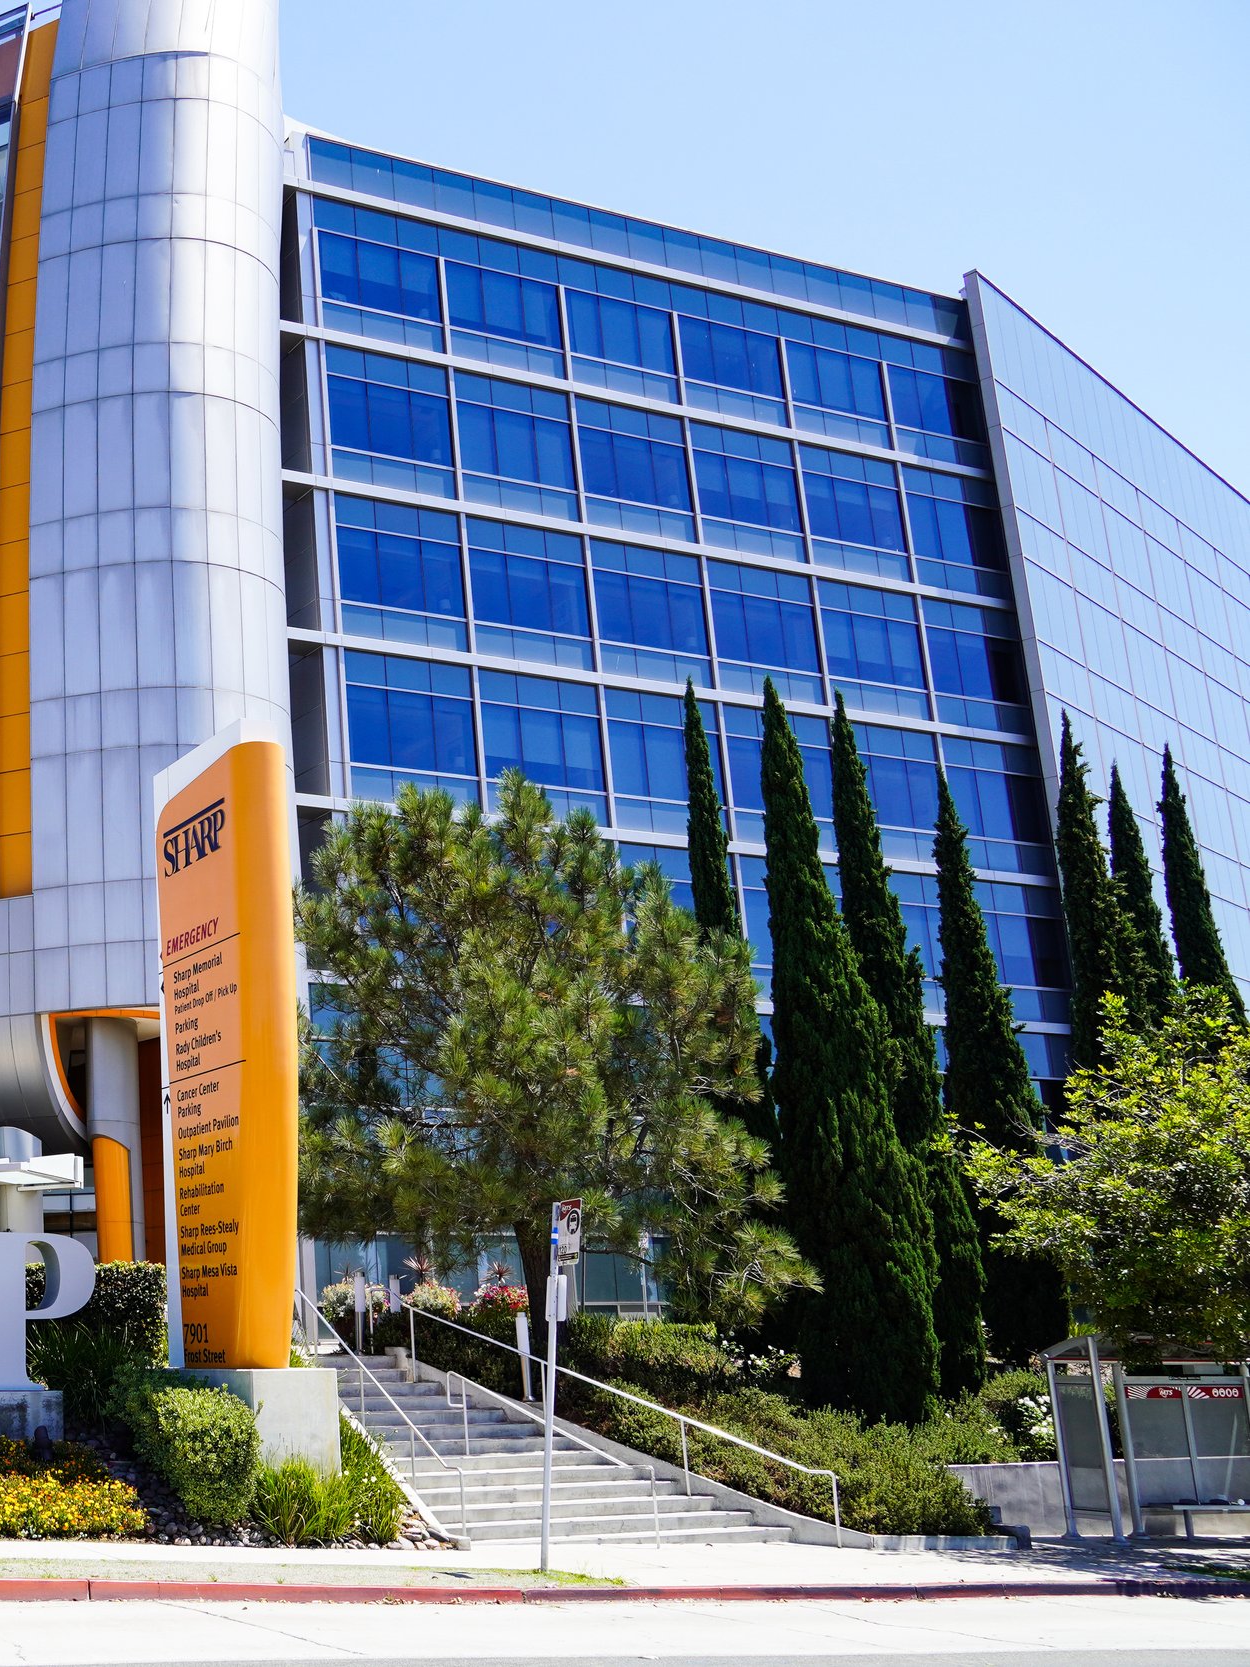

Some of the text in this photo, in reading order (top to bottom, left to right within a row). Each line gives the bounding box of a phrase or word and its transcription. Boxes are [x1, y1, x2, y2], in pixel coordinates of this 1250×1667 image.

[163, 808, 225, 878] SHARP
[166, 917, 219, 957] EMERGENCY
[173, 951, 222, 984] Sharp Memorial
[174, 980, 200, 1000] Hospital
[174, 1002, 191, 1015] Patient
[193, 997, 204, 1009] Drop
[205, 990, 213, 1002] Off
[217, 985, 229, 998] Pick
[230, 983, 237, 995] Up
[175, 1017, 199, 1035] Parking
[176, 1029, 222, 1055] Rady Children's
[176, 1052, 201, 1072] Hospital
[177, 1081, 220, 1102] Cancer Center
[177, 1102, 201, 1118] Parking
[178, 1114, 239, 1140] Outpatient Pavilion
[179, 1137, 233, 1161] Sharp Mary Birch
[179, 1161, 205, 1179] Hospital
[179, 1181, 225, 1200] Rehabilitation
[180, 1204, 200, 1217] Center
[180, 1218, 239, 1240] Sharp Rees-Stealy
[181, 1240, 227, 1257] Medical Group
[181, 1262, 237, 1281] Sharp Mesa Vista
[182, 1283, 209, 1300] Hospital
[183, 1323, 209, 1345] 7901
[183, 1348, 226, 1364] Frost Street
